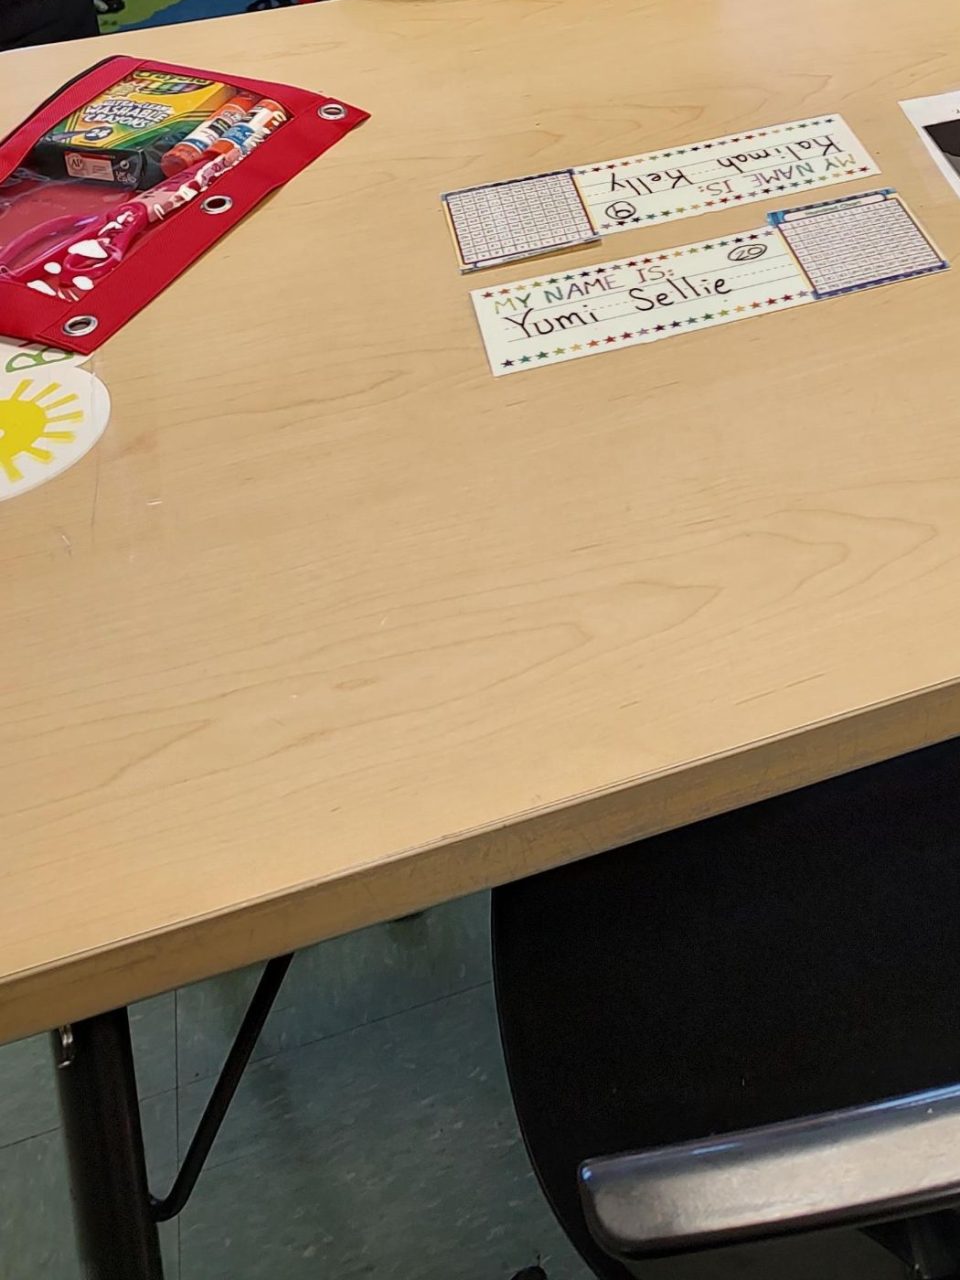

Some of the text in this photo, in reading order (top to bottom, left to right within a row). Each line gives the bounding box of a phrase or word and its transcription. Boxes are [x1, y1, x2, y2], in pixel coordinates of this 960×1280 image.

[85, 104, 170, 125] WASHABLE
[611, 135, 844, 197] Kalimah Kelly
[744, 162, 815, 187] NAME
[825, 154, 857, 171] MY
[494, 265, 674, 314] MY NAME IS:
[503, 276, 732, 338] Yumi Sellie
